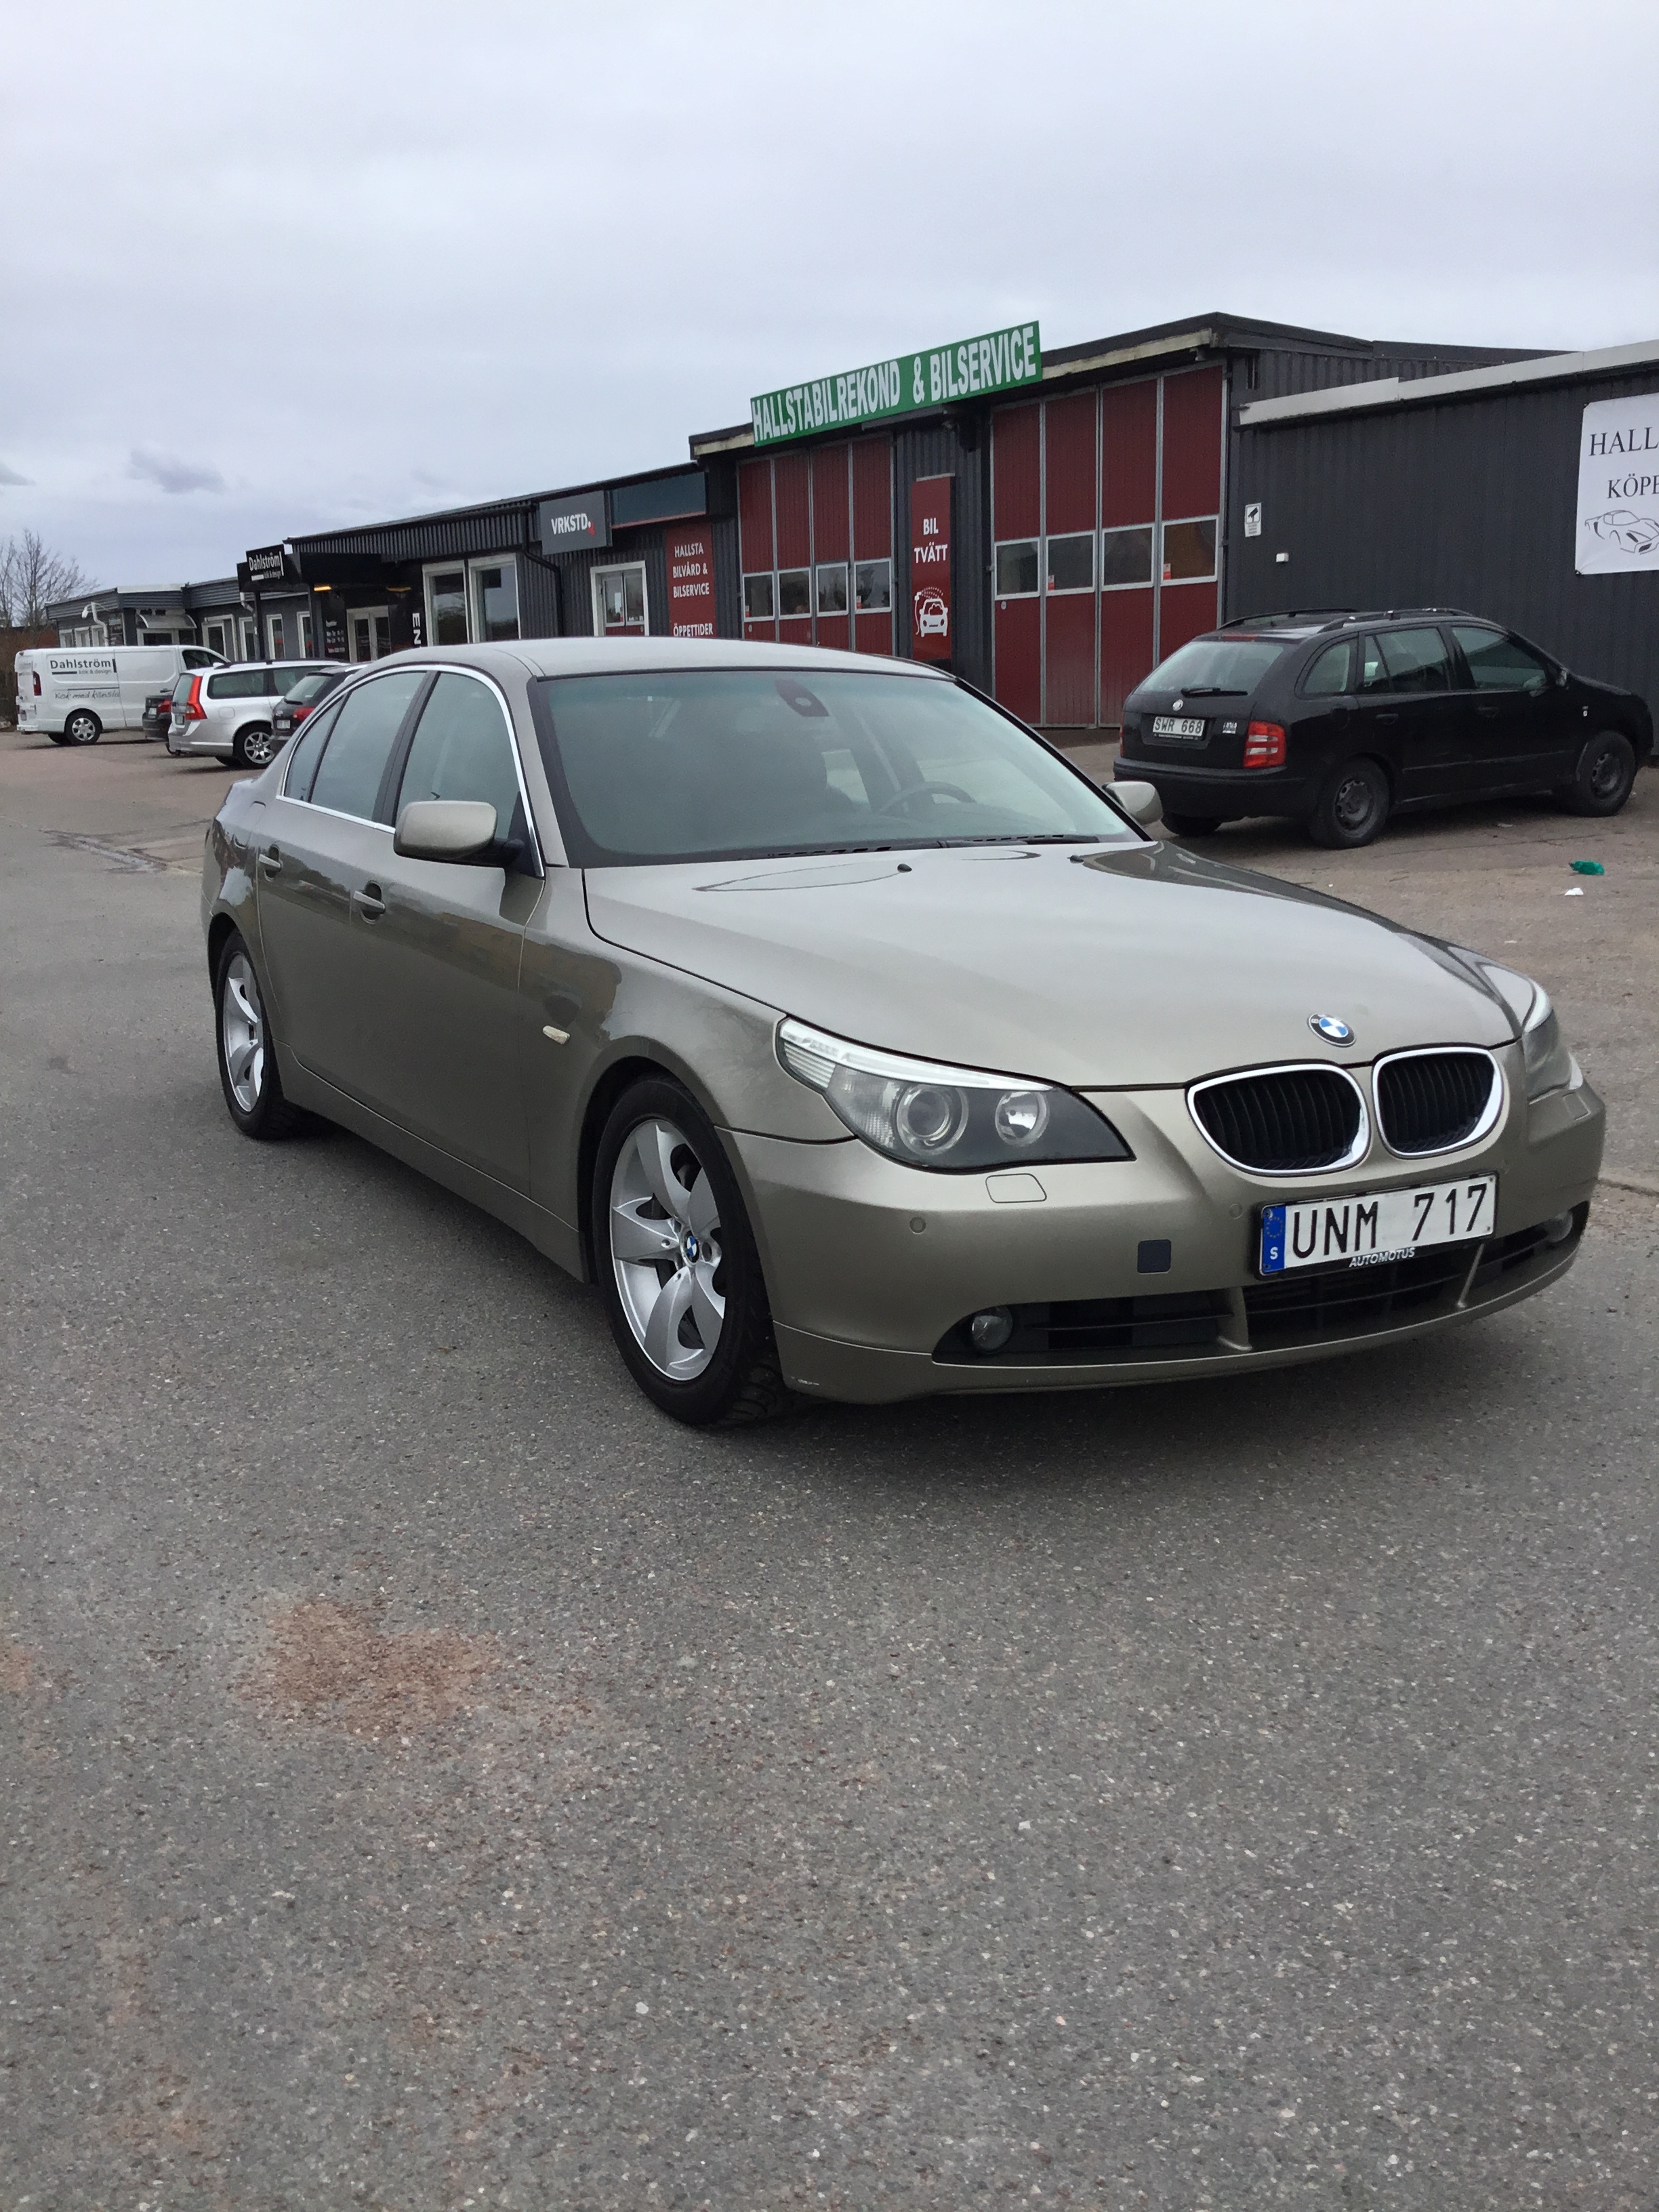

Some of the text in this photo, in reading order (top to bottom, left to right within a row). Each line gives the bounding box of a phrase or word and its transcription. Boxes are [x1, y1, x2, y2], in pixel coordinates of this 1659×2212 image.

[751, 326, 1036, 442] HALLSTABILREKOND & BILSERVICE
[1589, 427, 1659, 456] HALL
[923, 517, 939, 535] BIL
[674, 543, 703, 558] HALLSTA
[914, 543, 947, 563] TVÄTT
[249, 552, 281, 571] Dahlström
[673, 561, 708, 578] BILVÅRD &
[673, 583, 710, 598] BILSERVICE
[412, 613, 422, 646] EN
[673, 623, 713, 636] ÖPPETTIDER
[50, 659, 111, 669] Dahlström
[1155, 718, 1202, 734] SWR 668
[1292, 1183, 1488, 1259] UNM 717
[1270, 1246, 1278, 1260] S
[1349, 1247, 1415, 1267] AUTOMOTUS
